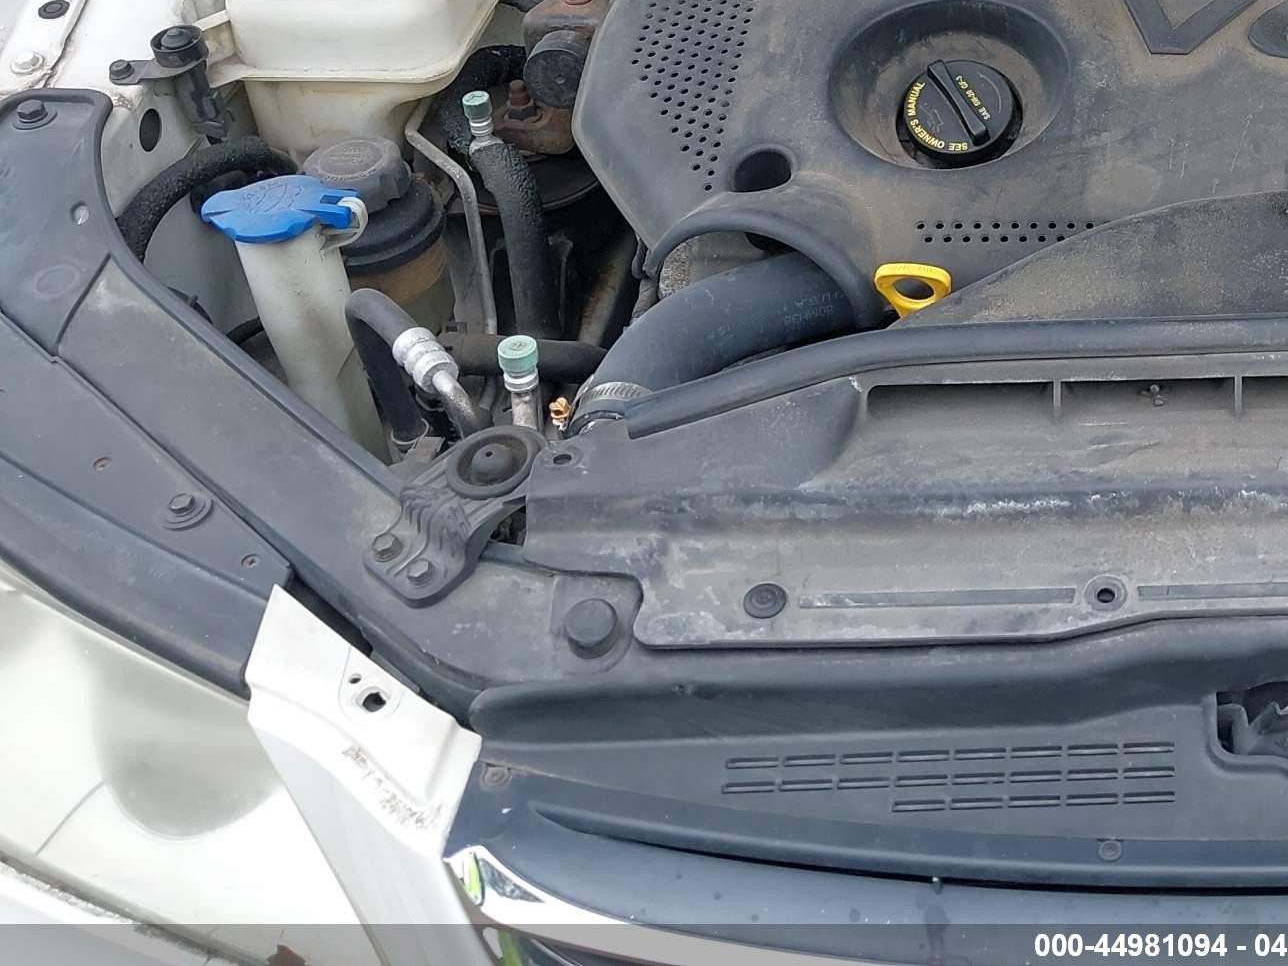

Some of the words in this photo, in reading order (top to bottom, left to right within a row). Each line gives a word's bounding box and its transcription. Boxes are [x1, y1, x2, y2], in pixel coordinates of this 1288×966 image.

[907, 82, 925, 116] MANUAL
[979, 106, 991, 120] SAE
[910, 119, 945, 149] OWNER'S
[948, 142, 968, 151] SEE
